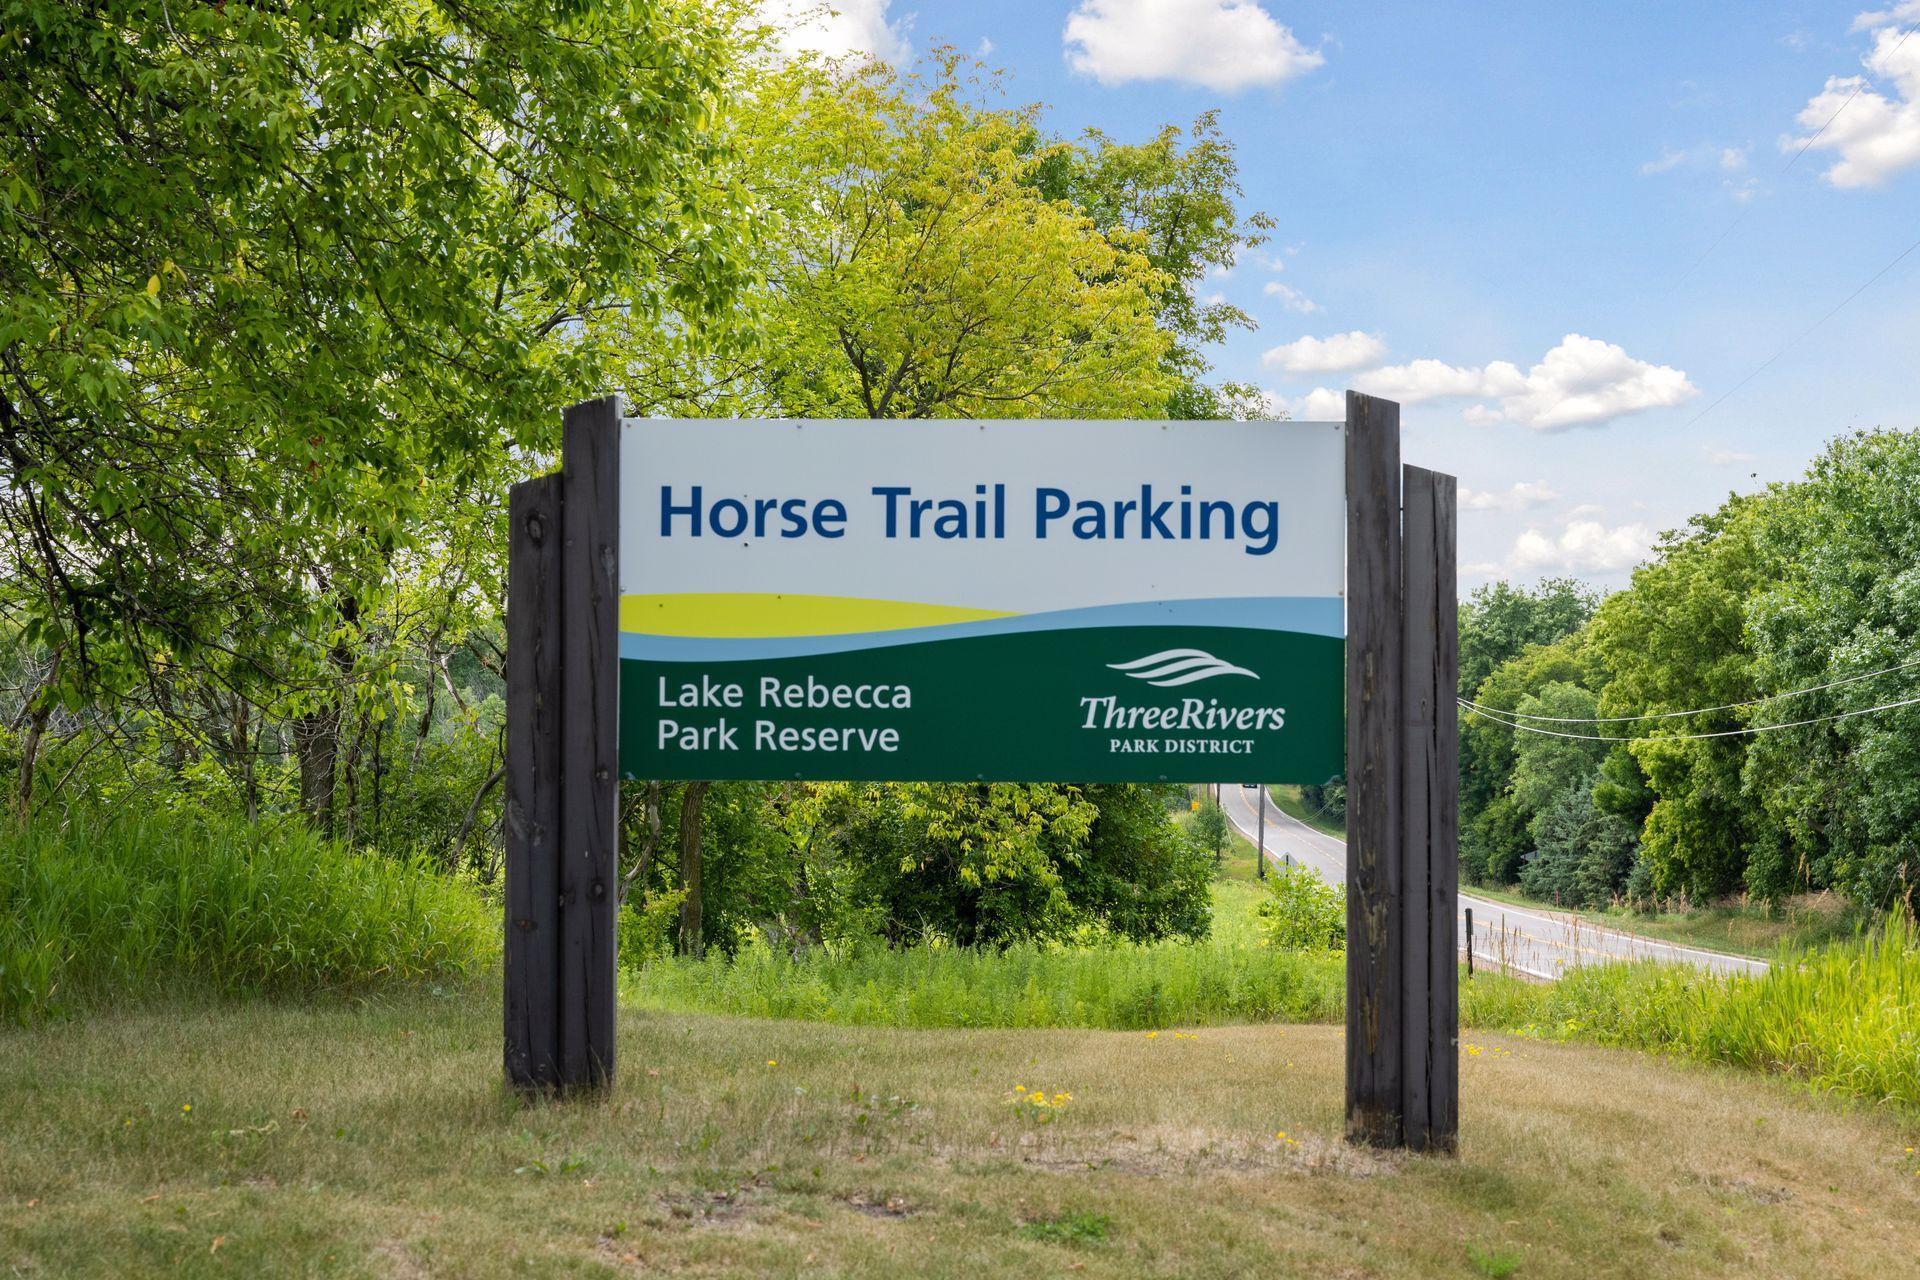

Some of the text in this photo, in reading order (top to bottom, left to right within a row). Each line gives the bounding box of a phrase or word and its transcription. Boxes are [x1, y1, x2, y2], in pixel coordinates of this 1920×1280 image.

[660, 483, 1279, 556] Horse Trail Parking
[659, 674, 911, 709] Lake Rebecca
[1080, 695, 1286, 730] ThreeRivers
[658, 717, 900, 752] Park Reserve
[1110, 739, 1254, 754] PARK DISTRICT
